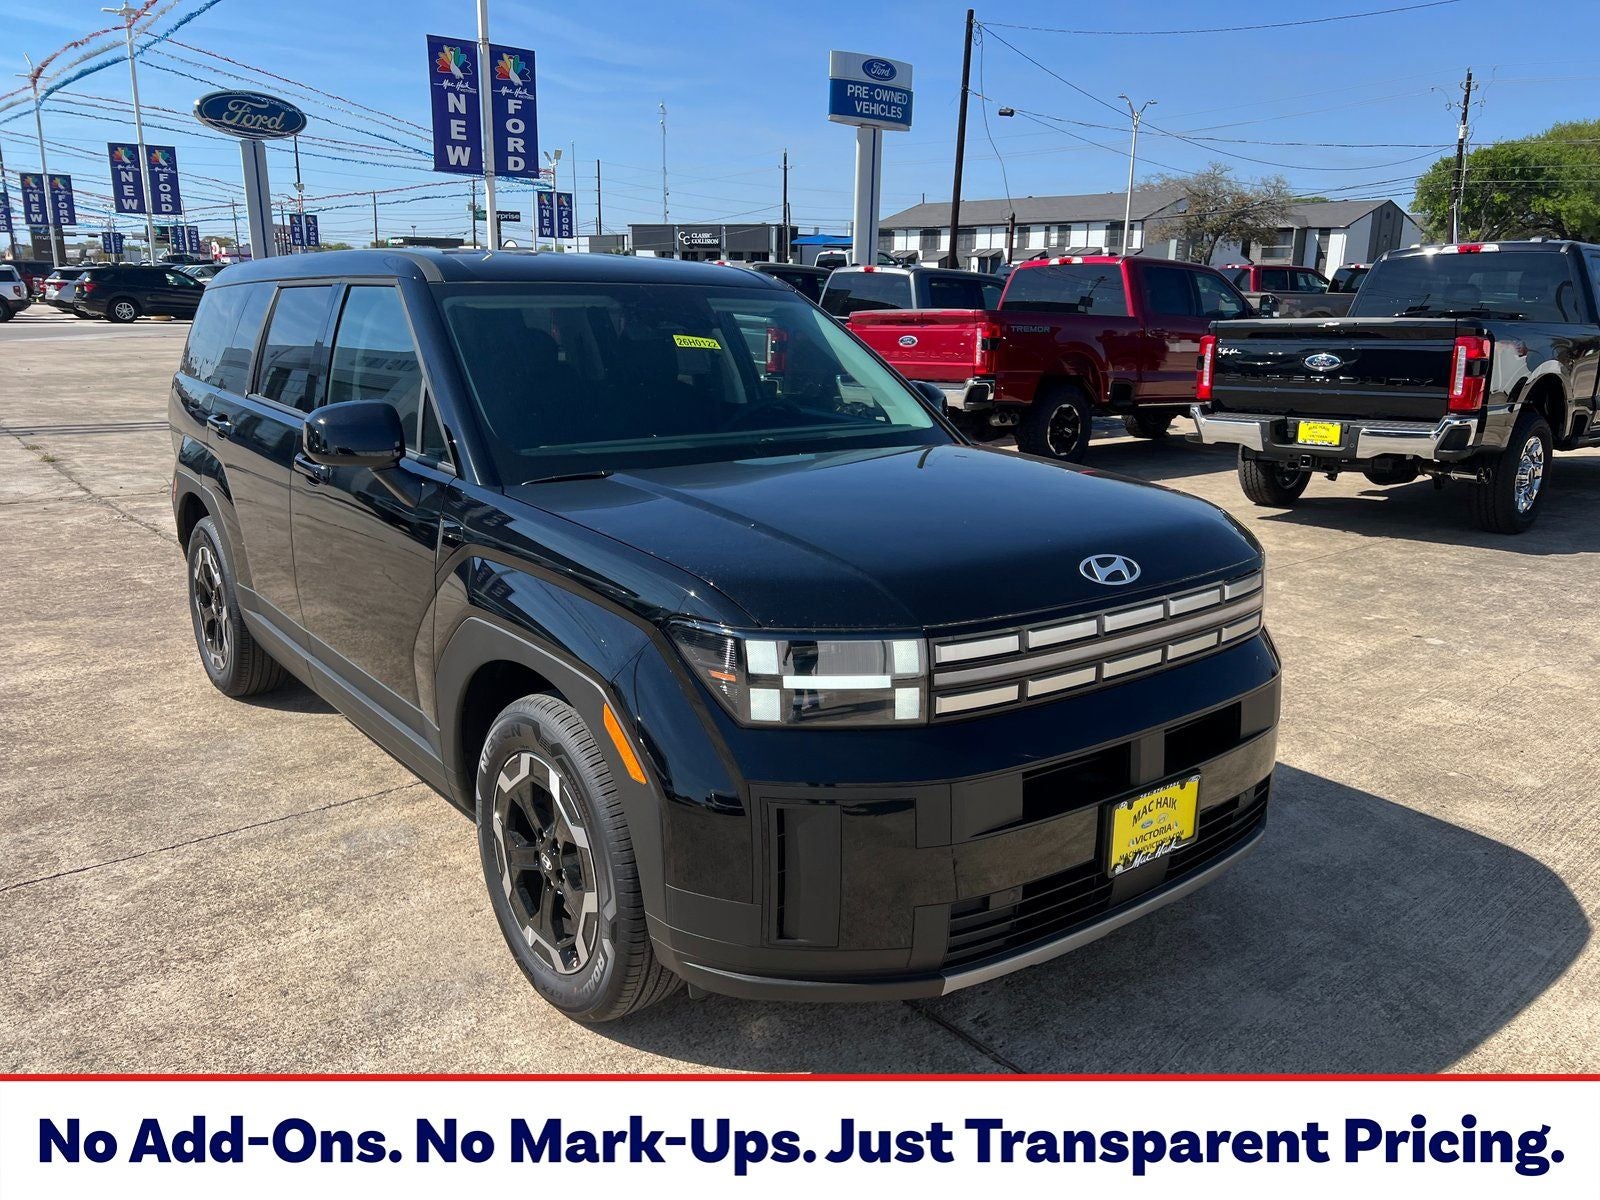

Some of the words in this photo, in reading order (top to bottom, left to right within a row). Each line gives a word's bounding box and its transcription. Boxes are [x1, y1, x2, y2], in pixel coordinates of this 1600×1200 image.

[871, 62, 891, 77] Ford
[222, 99, 285, 130] Ford
[855, 101, 903, 119] VEHICLES
[446, 92, 471, 167] NEW
[505, 99, 526, 172] FORD
[120, 171, 138, 210] NEW
[159, 174, 173, 213] FORD
[29, 193, 43, 223] NEW
[57, 194, 70, 224] FORD
[542, 209, 551, 236] NEW
[294, 226, 302, 245] NEW
[676, 337, 719, 348] 26H0122
[1010, 325, 1051, 333] TREMOR
[480, 723, 522, 775] NEEN
[1132, 800, 1154, 827] MAC
[1155, 796, 1178, 811] HAIK
[1134, 823, 1172, 845] VICTORIA
[1132, 850, 1155, 869] Mac
[1155, 838, 1181, 859] Haik
